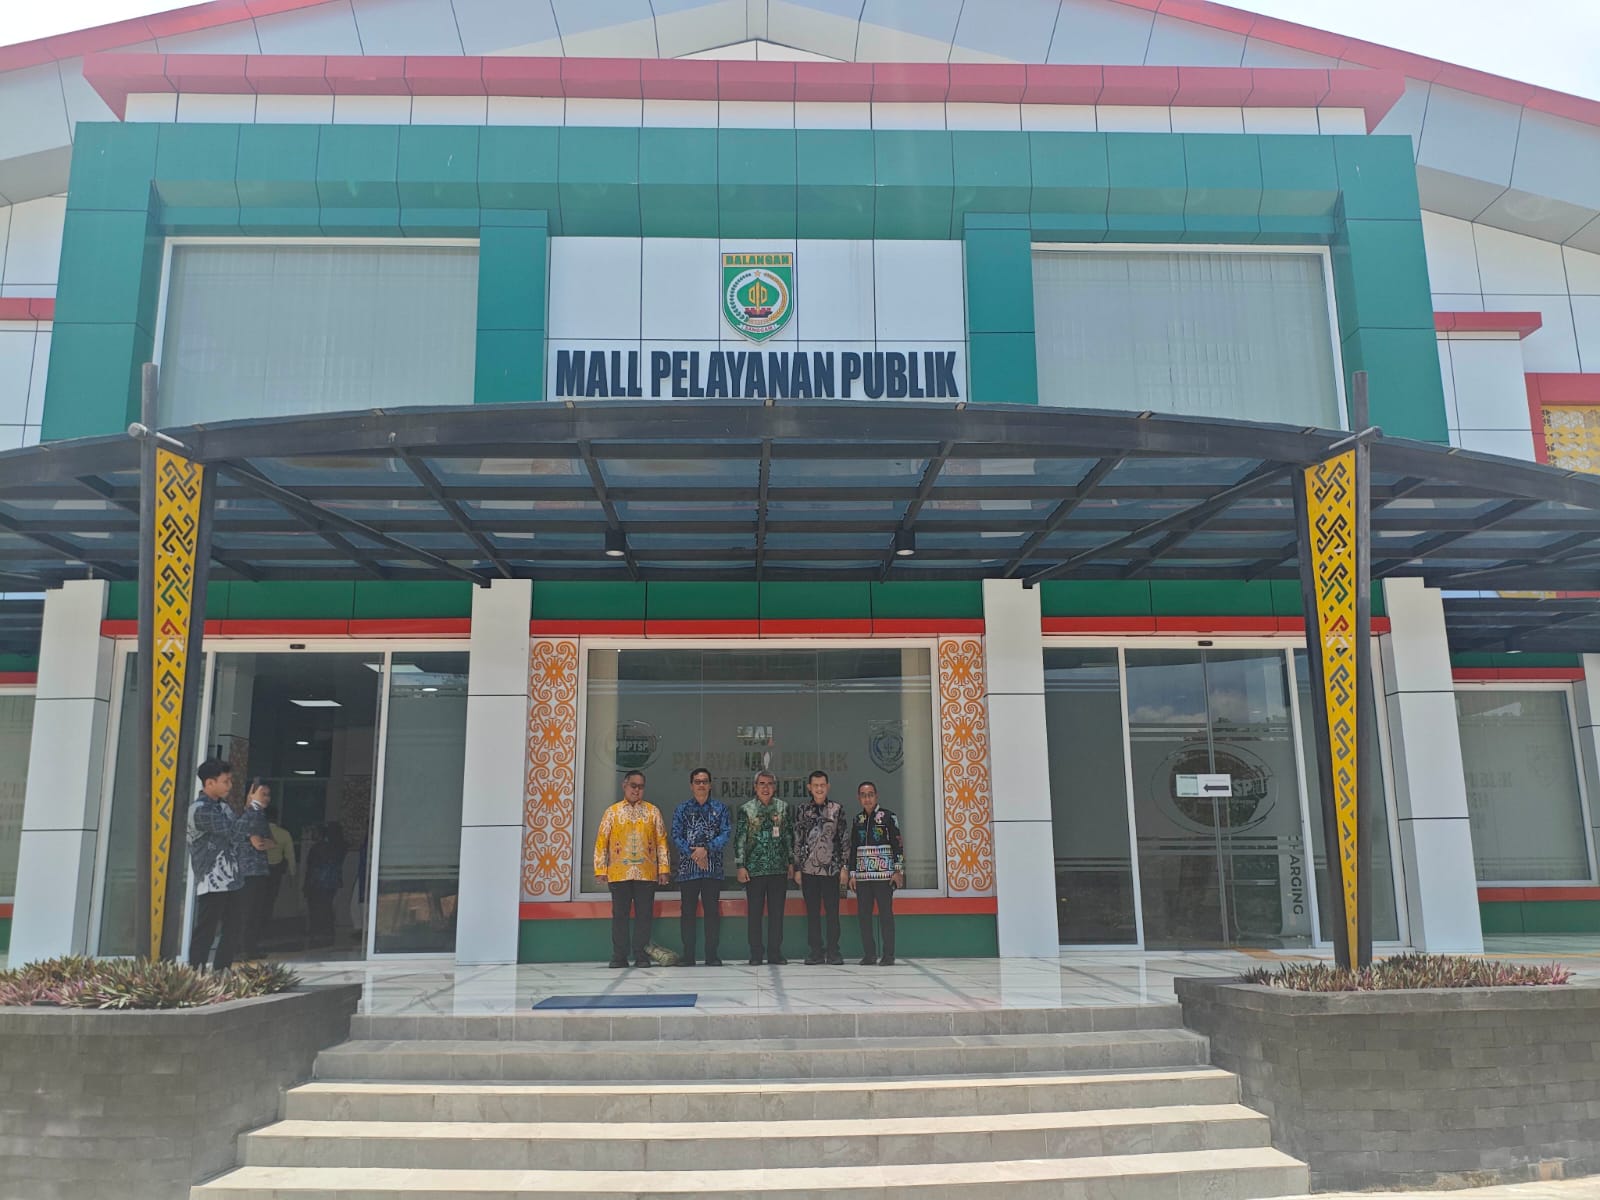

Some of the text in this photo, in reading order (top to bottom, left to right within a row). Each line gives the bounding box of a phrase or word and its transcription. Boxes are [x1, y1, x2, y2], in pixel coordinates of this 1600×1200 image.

[725, 254, 790, 265] BALANGAN
[555, 349, 960, 400] MALL PELAYANAN PUBLIK
